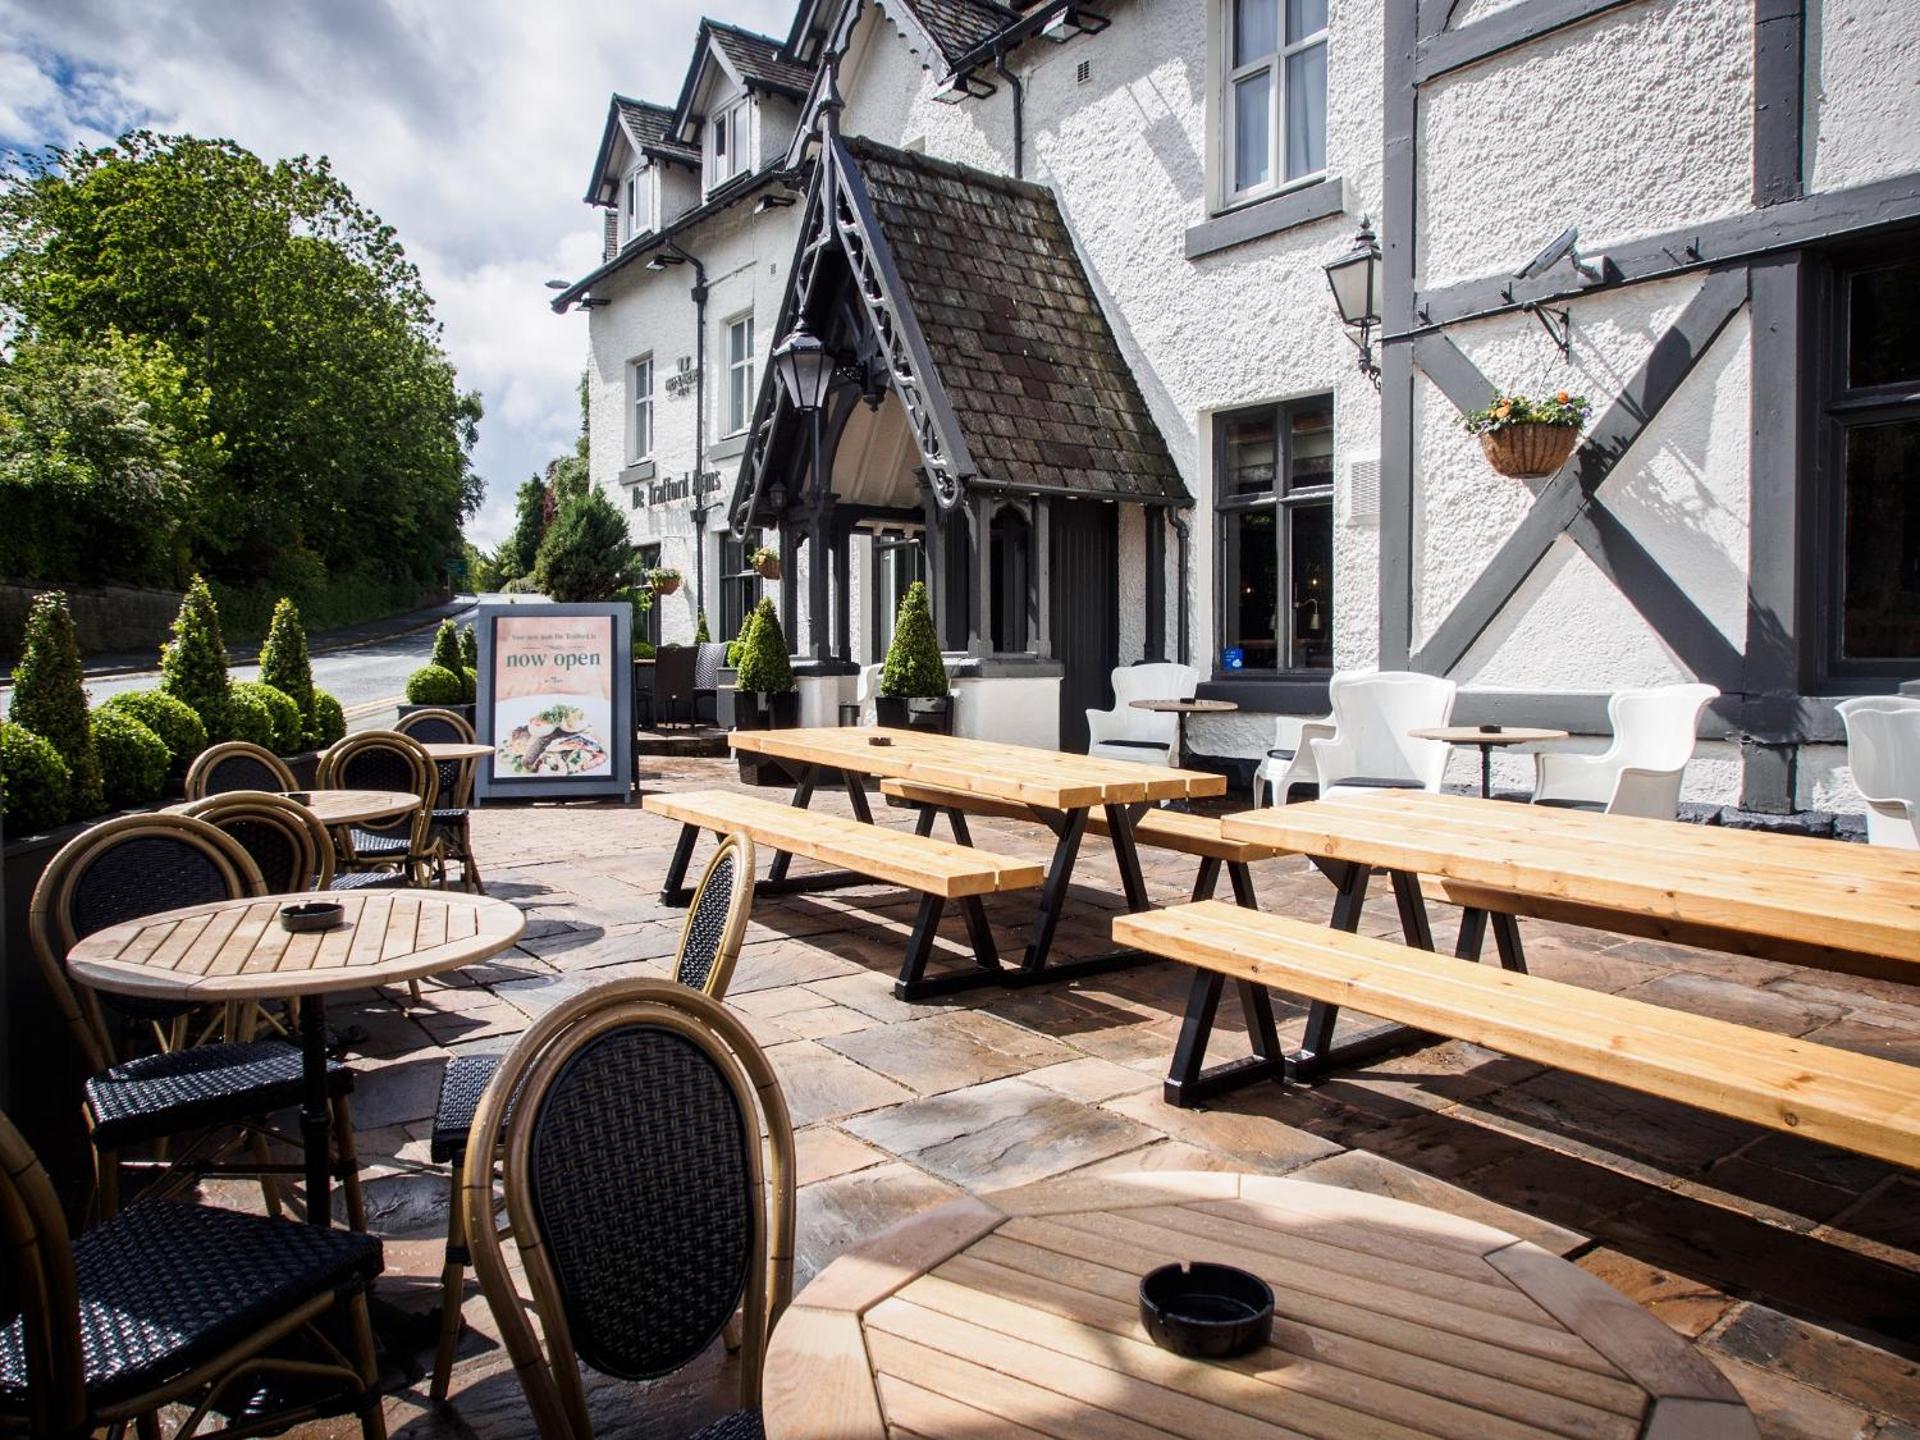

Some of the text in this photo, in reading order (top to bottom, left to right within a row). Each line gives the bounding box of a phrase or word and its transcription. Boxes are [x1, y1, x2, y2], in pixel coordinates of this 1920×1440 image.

[647, 472, 689, 506] Trafford
[506, 652, 600, 670] now open
